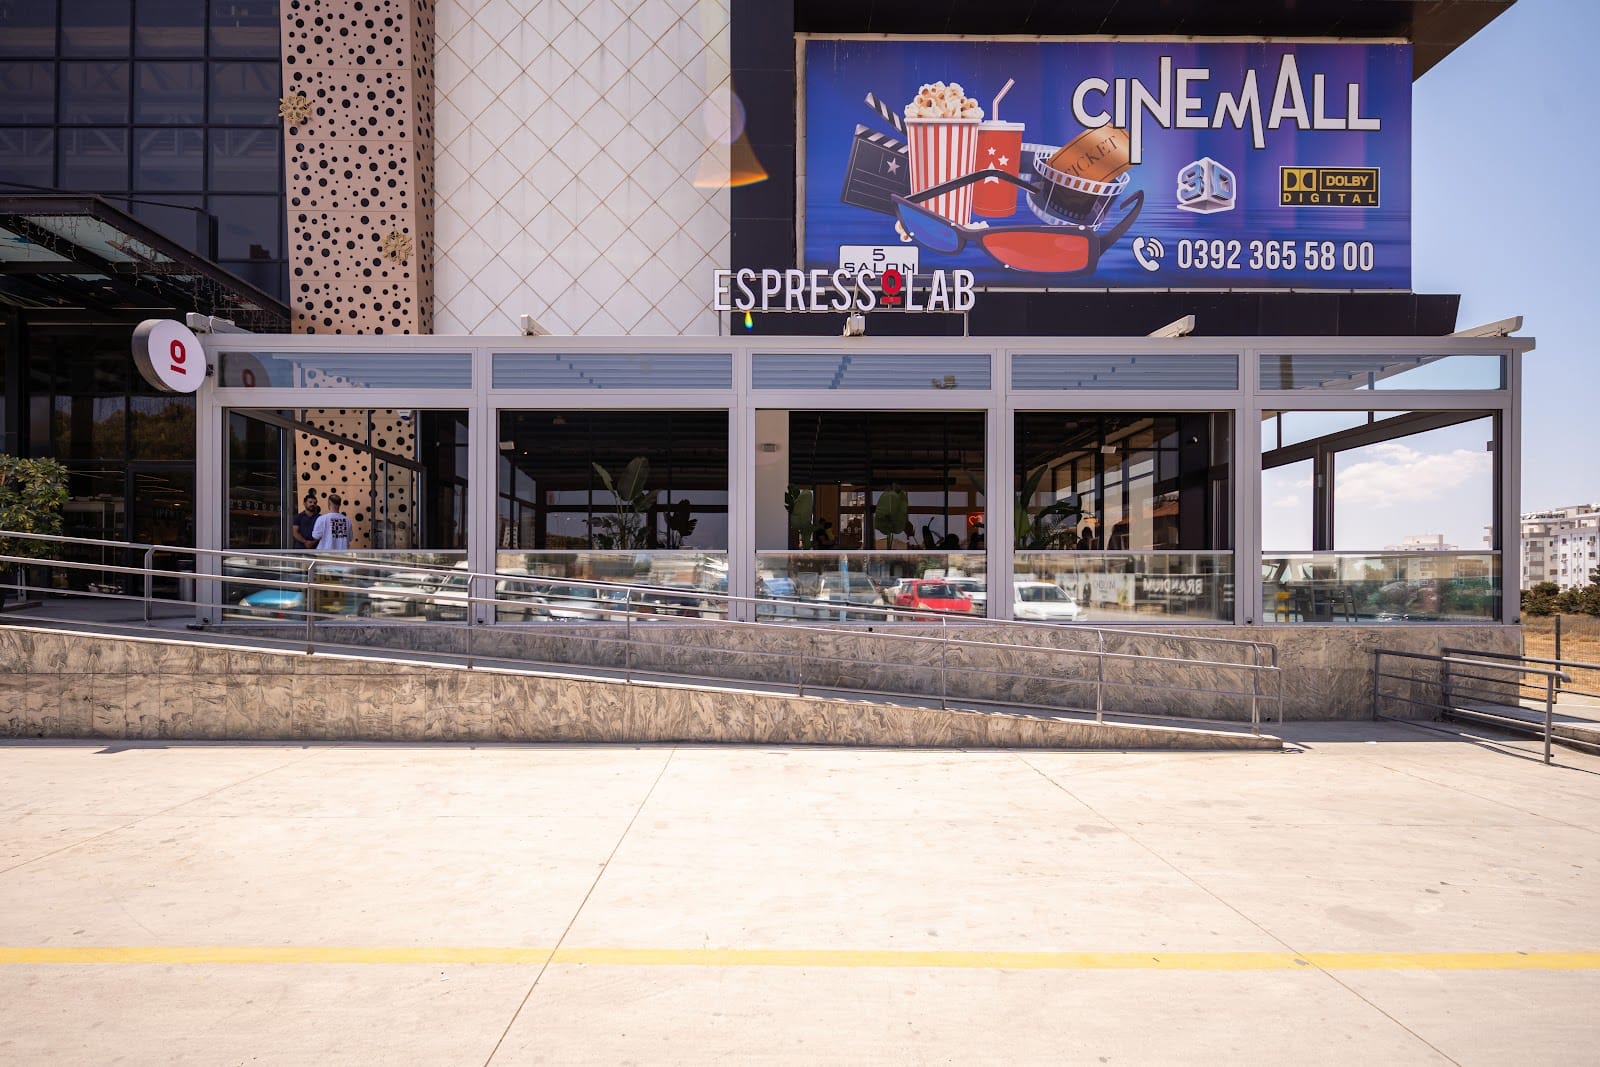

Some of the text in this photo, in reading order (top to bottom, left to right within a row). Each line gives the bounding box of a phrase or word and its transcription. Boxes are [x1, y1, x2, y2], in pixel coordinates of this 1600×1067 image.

[1072, 53, 1382, 165] CINEMALL
[1063, 135, 1118, 178] ICKET
[1179, 162, 1234, 202] 3D
[1325, 175, 1369, 187] DOLBY
[1283, 193, 1376, 203] DIGITAL
[872, 248, 886, 261] 5
[1177, 239, 1374, 271] 0392 365 58 00
[843, 262, 915, 274] SALON
